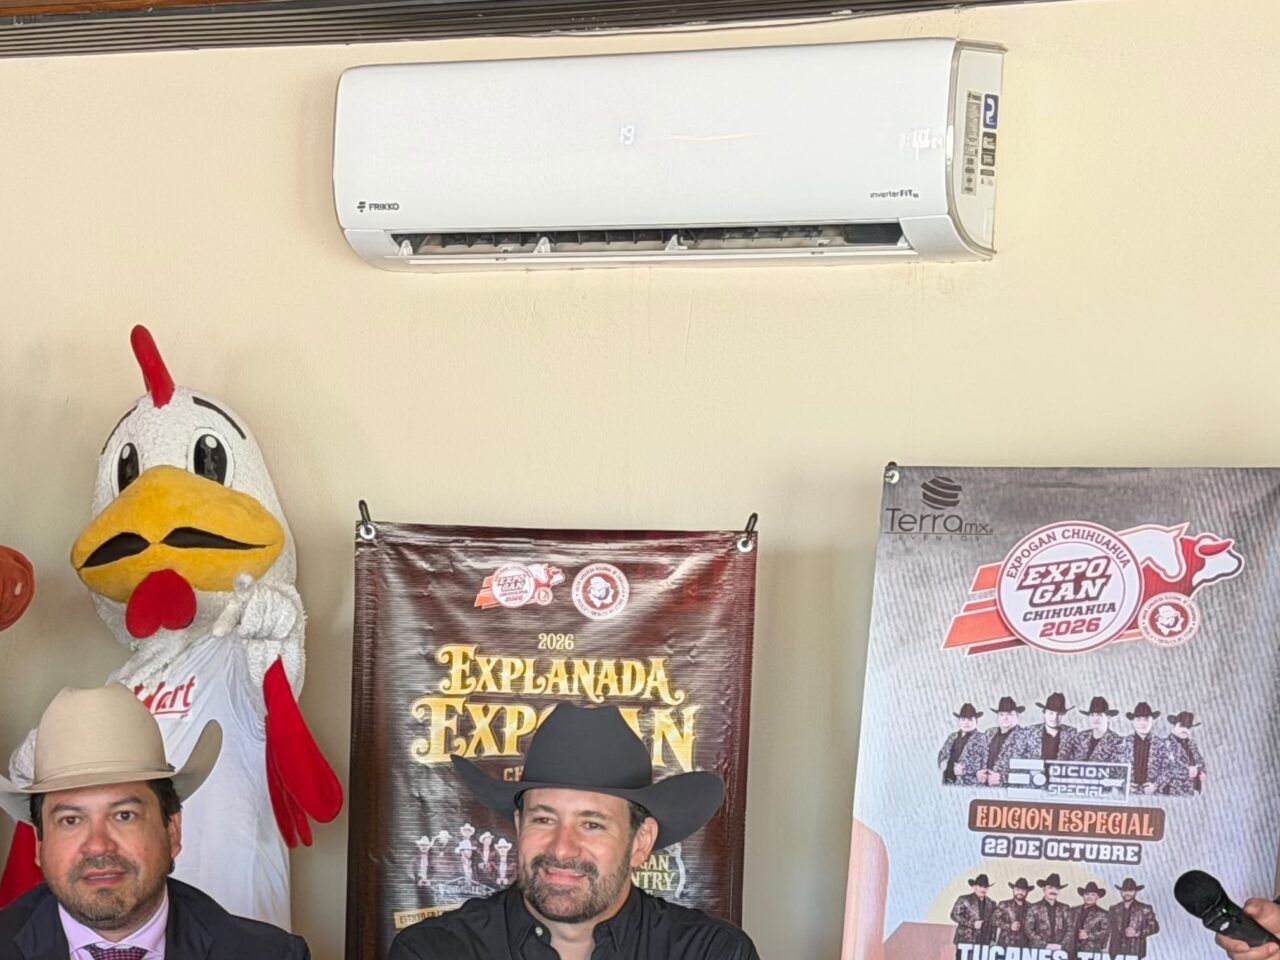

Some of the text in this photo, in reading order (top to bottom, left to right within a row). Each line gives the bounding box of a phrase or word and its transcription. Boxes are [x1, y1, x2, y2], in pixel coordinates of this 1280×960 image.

[1006, 528, 1131, 579] EXPOGAN CHIHUAHUA
[1021, 556, 1109, 586] EXPO
[1031, 577, 1106, 605] GAN
[1022, 602, 1116, 622] CHIHUAHUA
[537, 633, 575, 650] 2026
[1039, 617, 1102, 637] 2026
[436, 643, 686, 706] EXPLANADA
[410, 697, 701, 772] EXPN
[975, 805, 1155, 837] EDICION ESPECIAL
[984, 838, 1139, 862] 22 DE OCTUBRE
